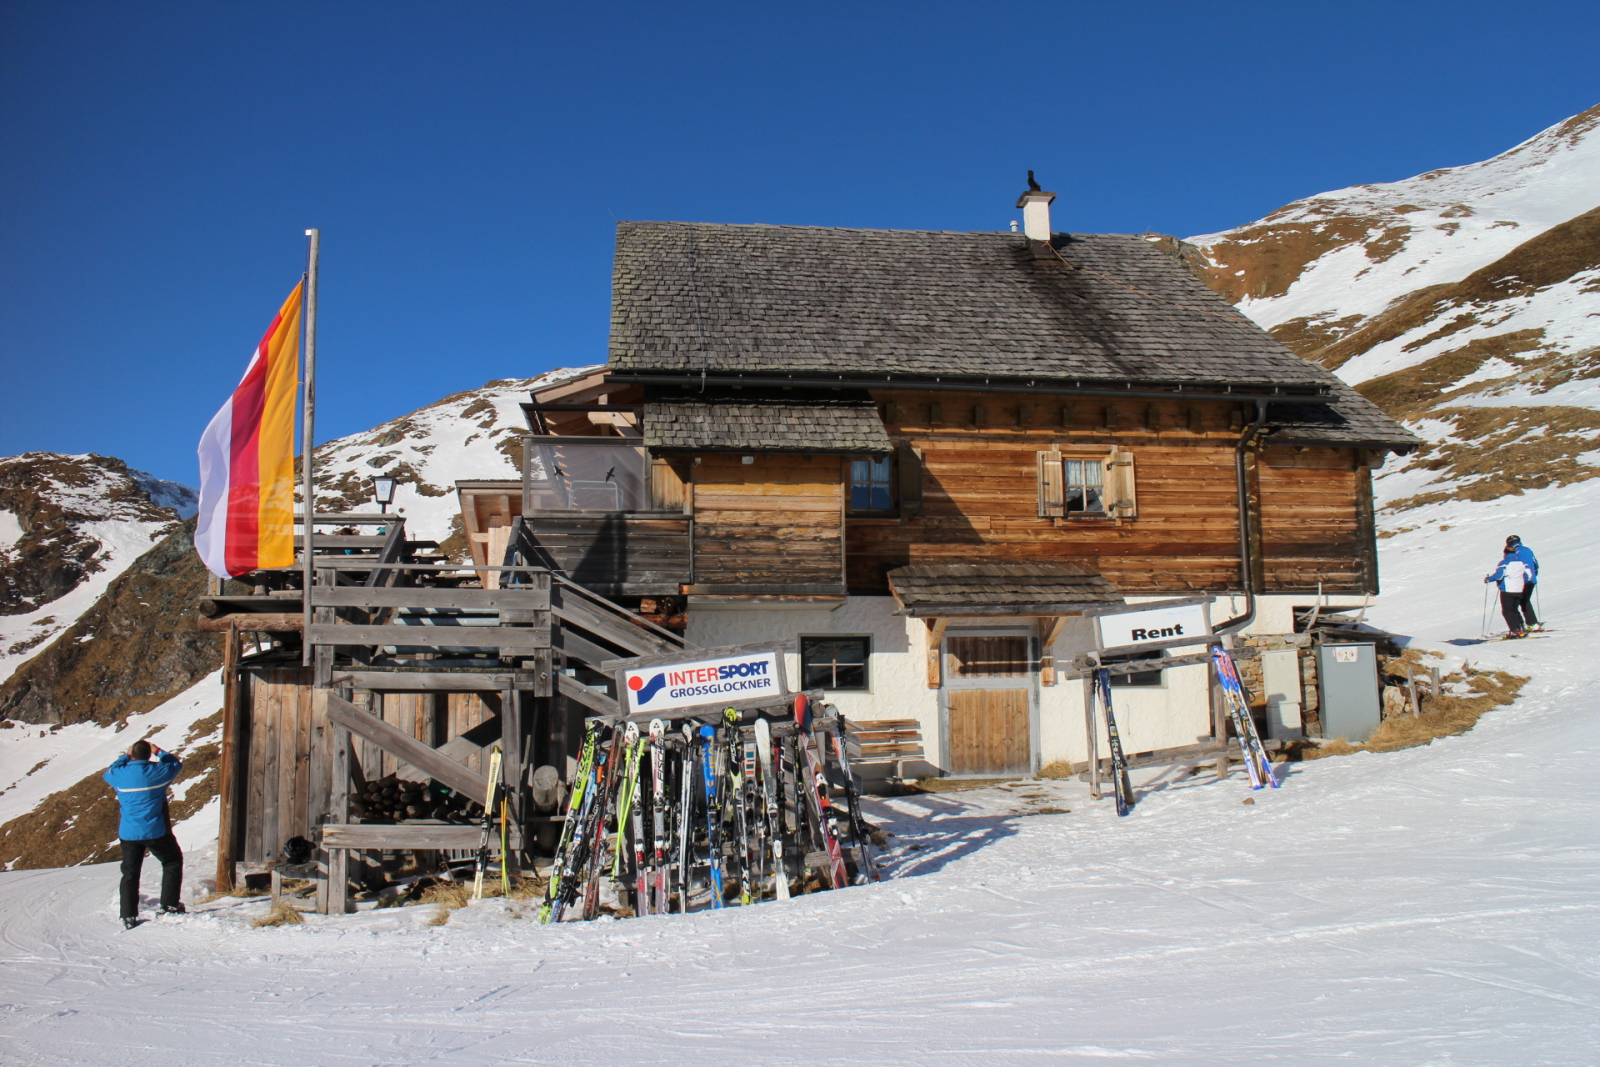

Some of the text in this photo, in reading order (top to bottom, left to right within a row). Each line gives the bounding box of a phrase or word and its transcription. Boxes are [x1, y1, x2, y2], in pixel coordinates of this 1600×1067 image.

[1131, 623, 1184, 641] Rent
[669, 660, 769, 686] INTERSPORT
[670, 678, 771, 699] GROSSGLOCKNER
